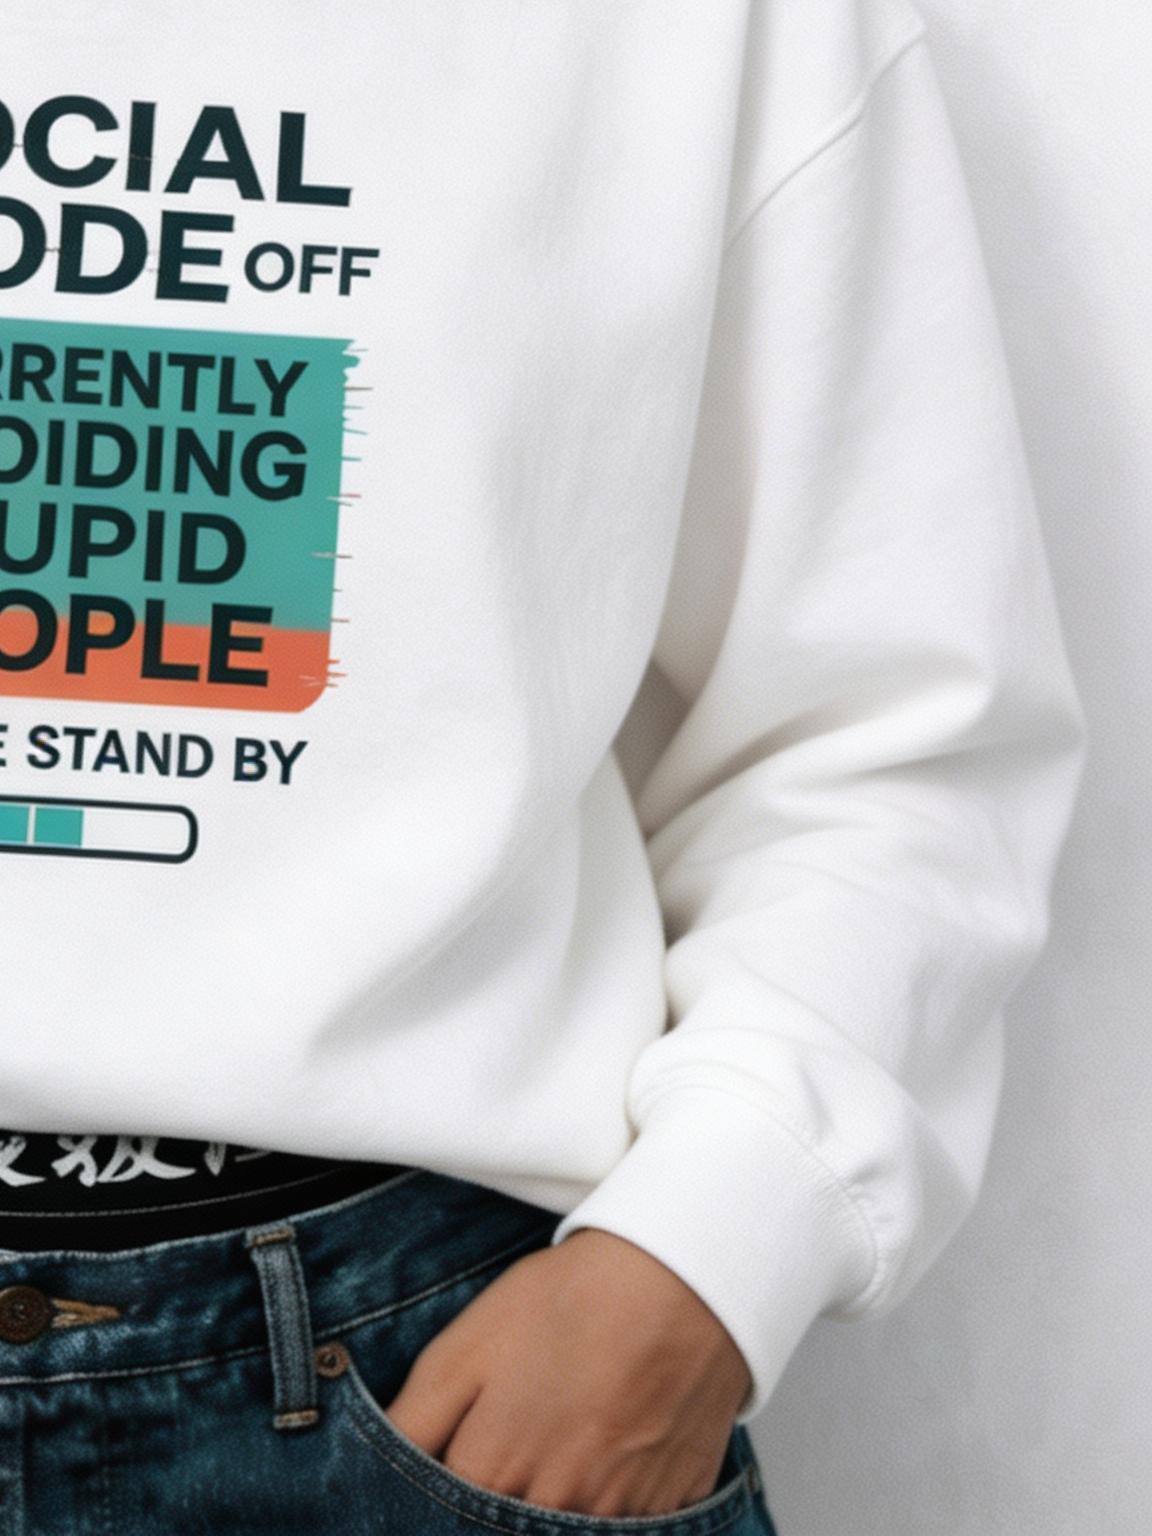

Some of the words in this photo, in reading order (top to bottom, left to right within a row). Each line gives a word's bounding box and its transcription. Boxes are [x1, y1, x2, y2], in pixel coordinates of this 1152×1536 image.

[244, 242, 380, 296] OFF
[27, 725, 214, 779] STAND
[233, 738, 308, 786] BY
